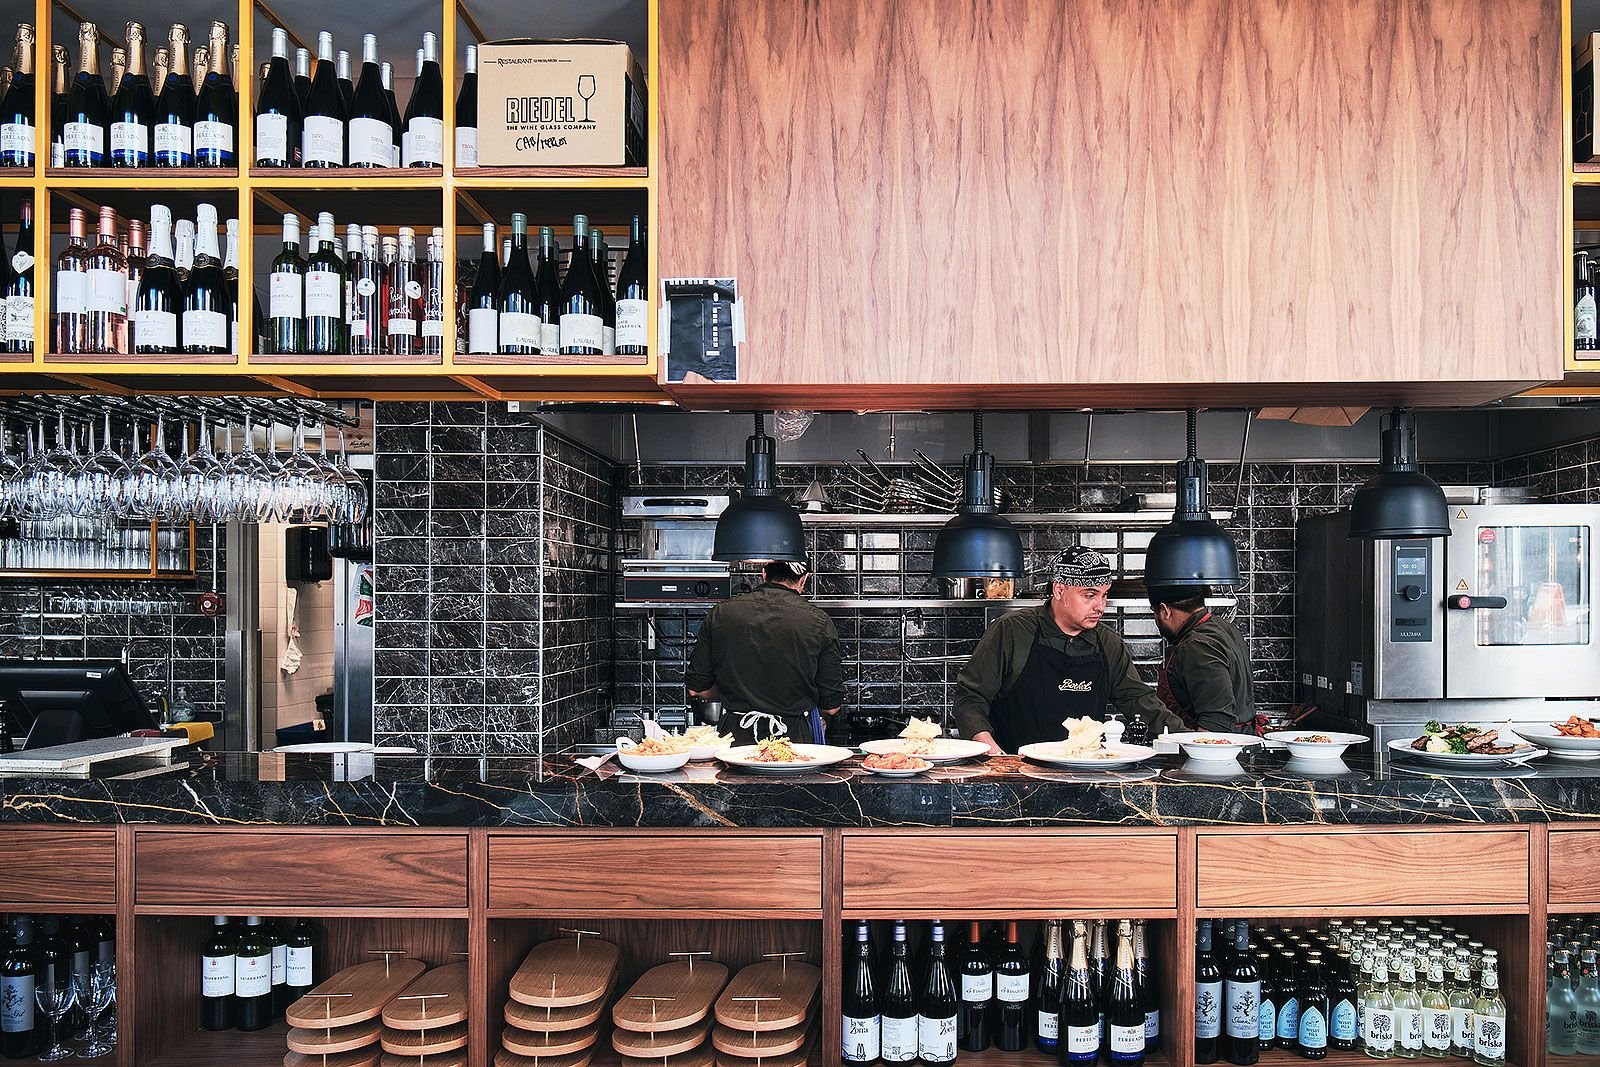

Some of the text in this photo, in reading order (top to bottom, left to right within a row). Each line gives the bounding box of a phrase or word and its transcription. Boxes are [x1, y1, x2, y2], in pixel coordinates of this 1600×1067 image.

[497, 58, 532, 67] RESTAURANT
[506, 97, 575, 123] RIEDEL
[516, 337, 538, 346] LAUREL
[573, 337, 595, 345] LAUREL
[540, 346, 559, 354] AUREL
[1370, 1030, 1393, 1040] briska
[1461, 1030, 1475, 1039] bris
[1478, 1036, 1503, 1048] briska
